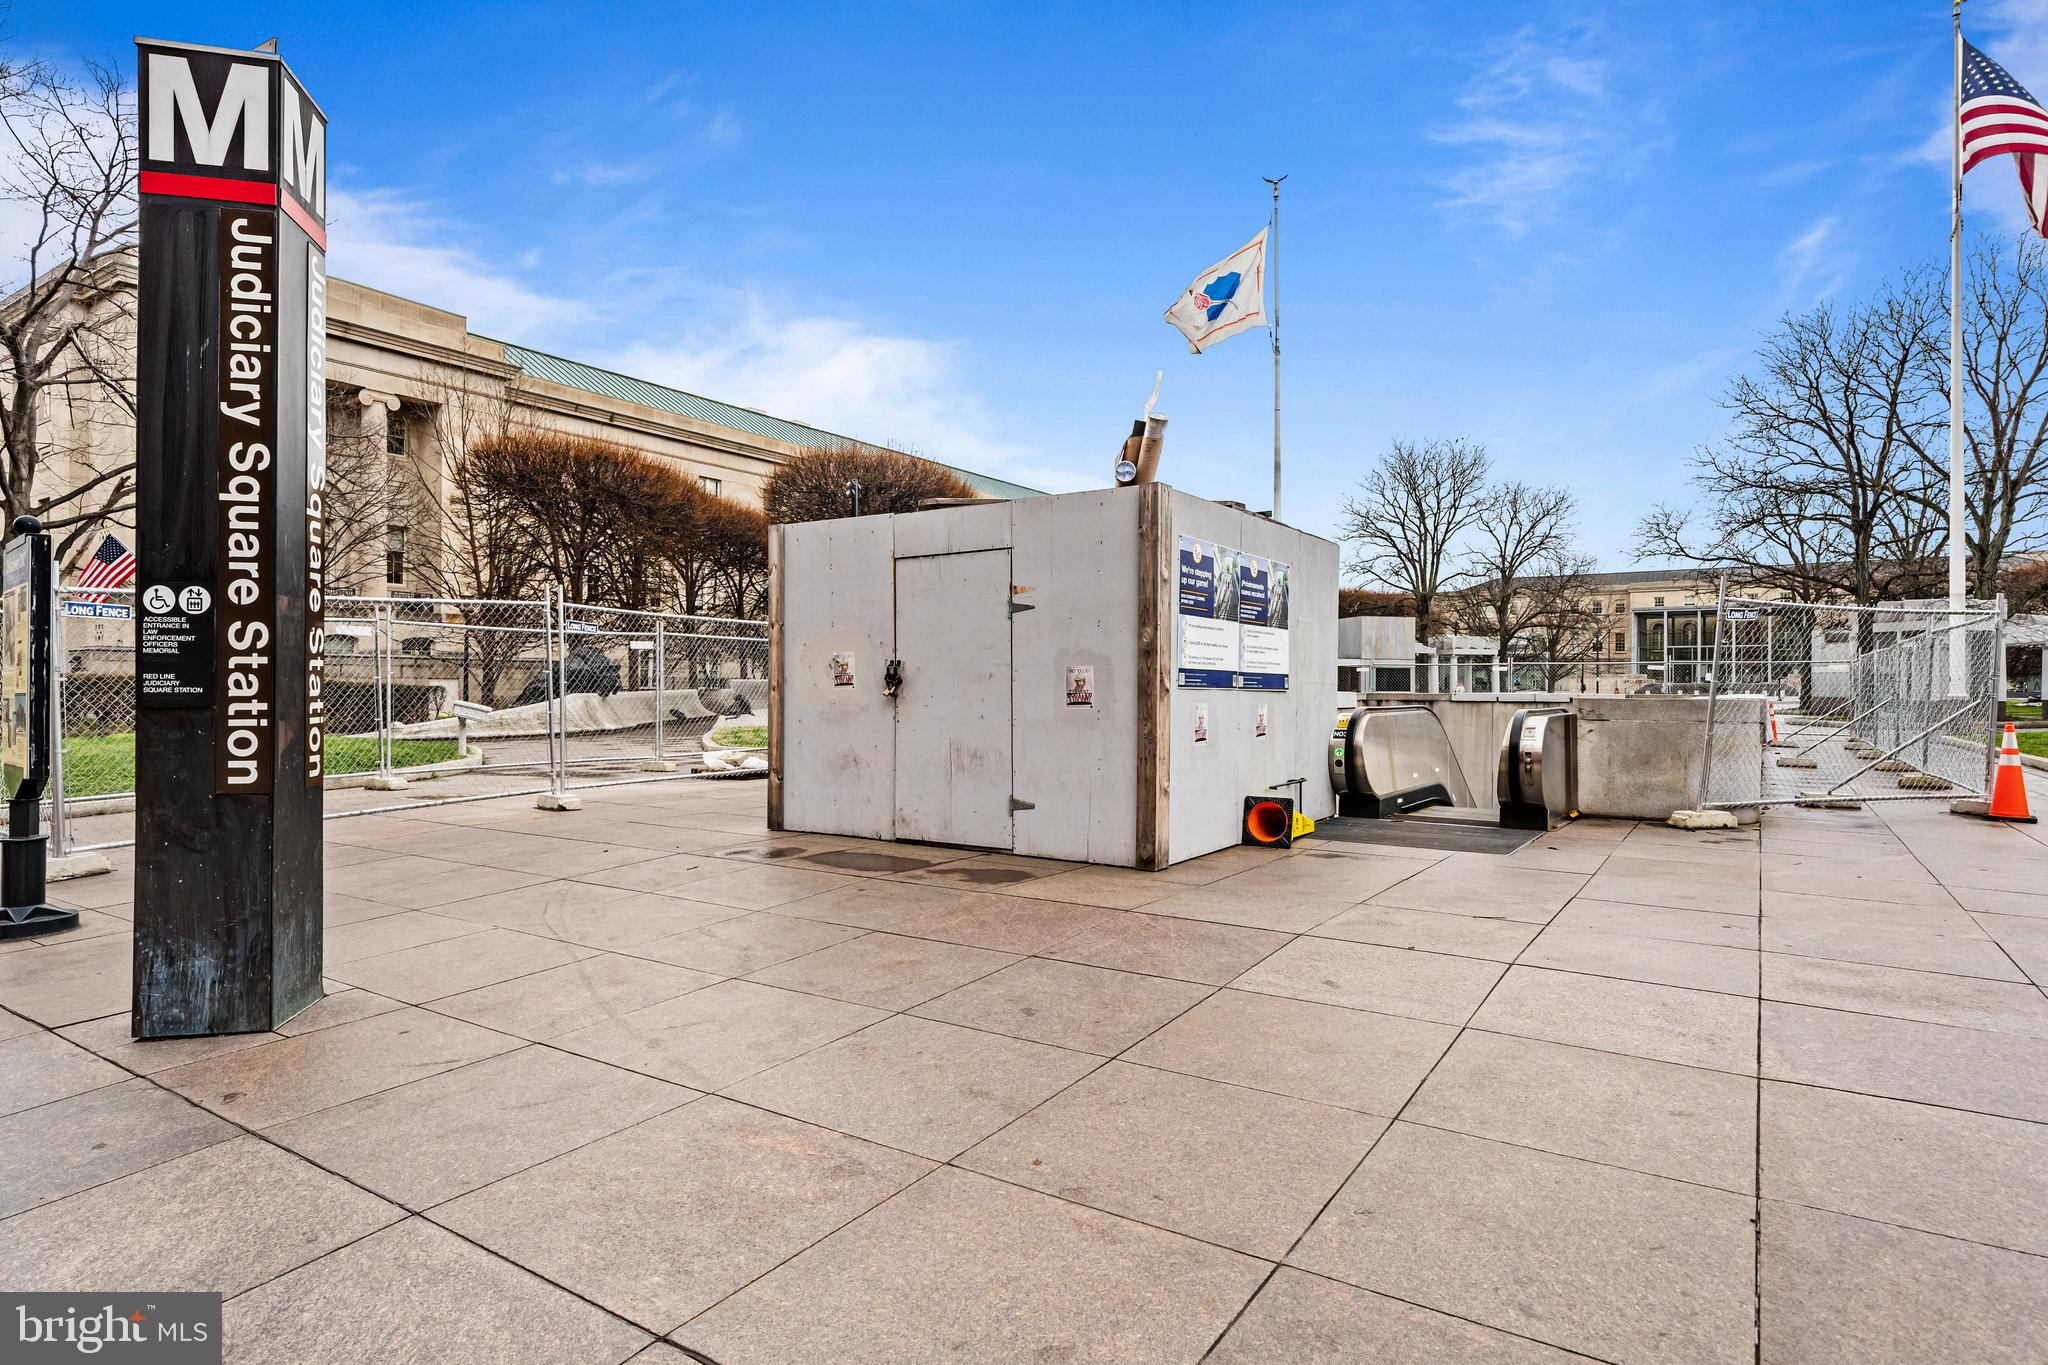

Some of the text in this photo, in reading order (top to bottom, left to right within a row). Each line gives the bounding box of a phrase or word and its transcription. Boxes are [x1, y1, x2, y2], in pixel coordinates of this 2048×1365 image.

[149, 53, 269, 171] M
[284, 77, 325, 220] M
[219, 218, 272, 785] Judiciary Square Station
[306, 255, 325, 779] Judiciary Square Station
[66, 604, 128, 618] LONG FENCE
[1728, 609, 1744, 619] LONG
